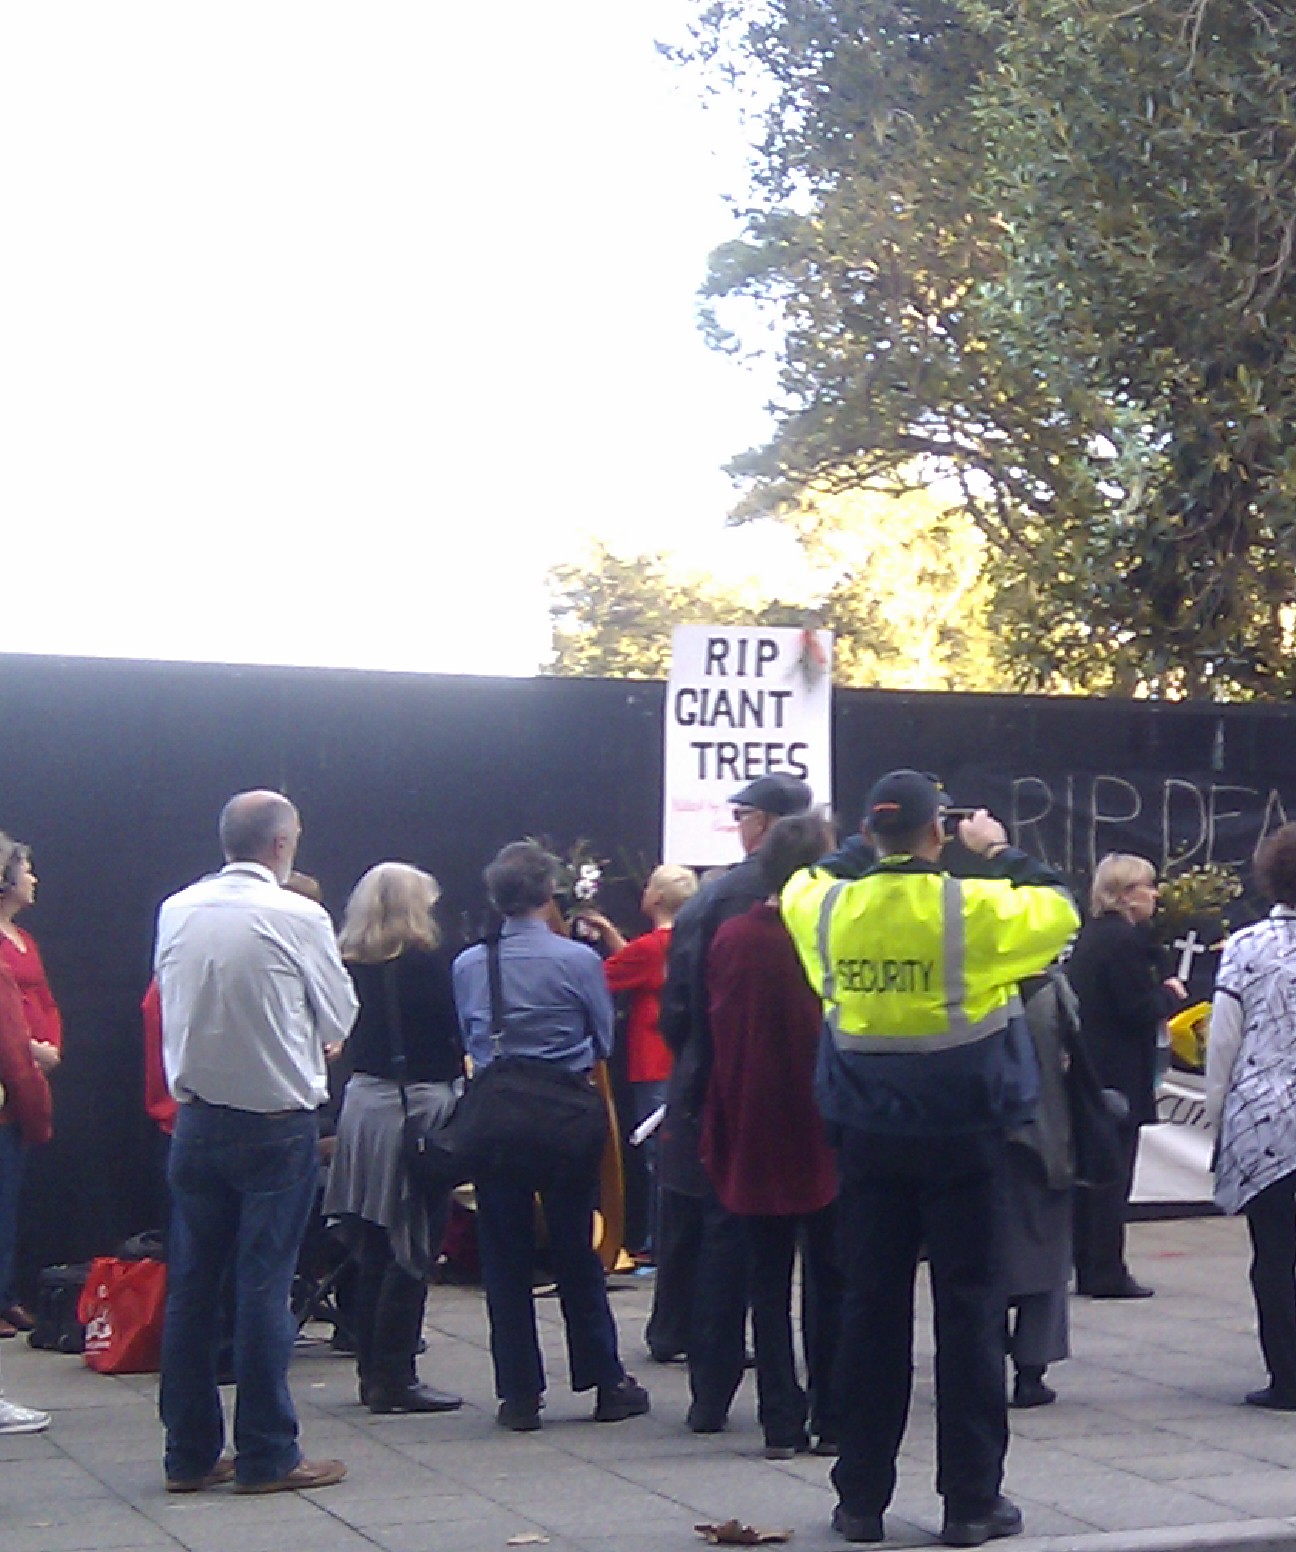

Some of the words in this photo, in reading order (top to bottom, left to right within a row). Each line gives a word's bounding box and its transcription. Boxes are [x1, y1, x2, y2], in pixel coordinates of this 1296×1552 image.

[704, 637, 780, 677] RIP
[674, 688, 793, 729] GIANT
[690, 741, 810, 781] TREES
[1011, 775, 1142, 878] RIP
[837, 959, 934, 992] SECURITY
